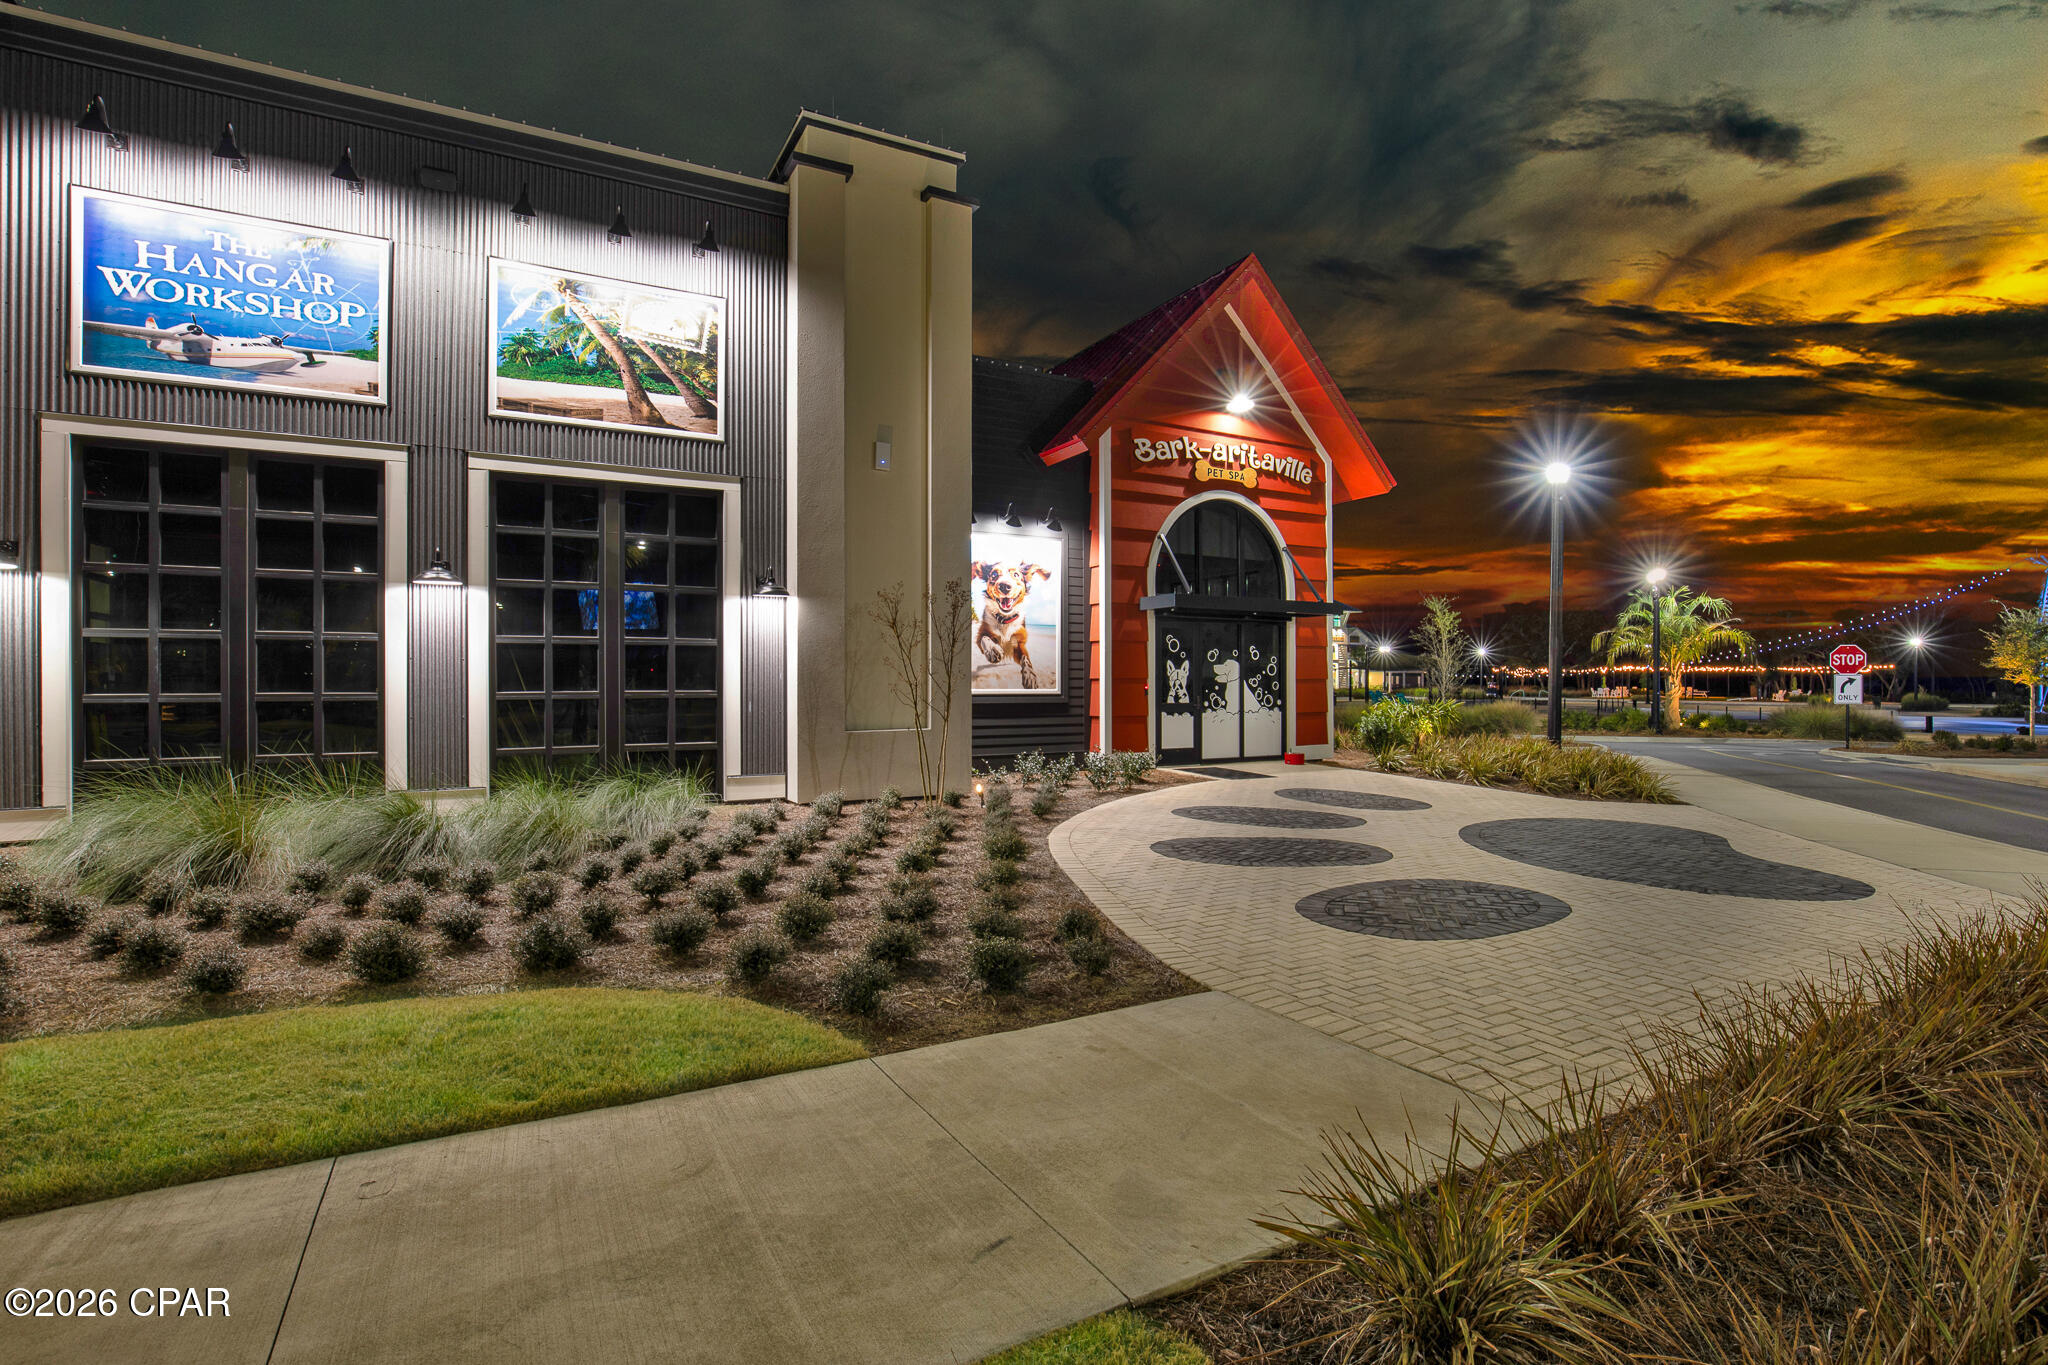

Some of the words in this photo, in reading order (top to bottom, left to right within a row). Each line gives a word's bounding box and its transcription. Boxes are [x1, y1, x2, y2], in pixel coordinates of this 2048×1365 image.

[205, 230, 272, 260] THE
[134, 240, 335, 297] HANGAR
[97, 265, 366, 328] WORKSHOP
[1133, 436, 1313, 485] Bark-aritaville
[1207, 468, 1223, 479] PET
[1229, 470, 1245, 481] SPA
[1832, 654, 1863, 665] STOP
